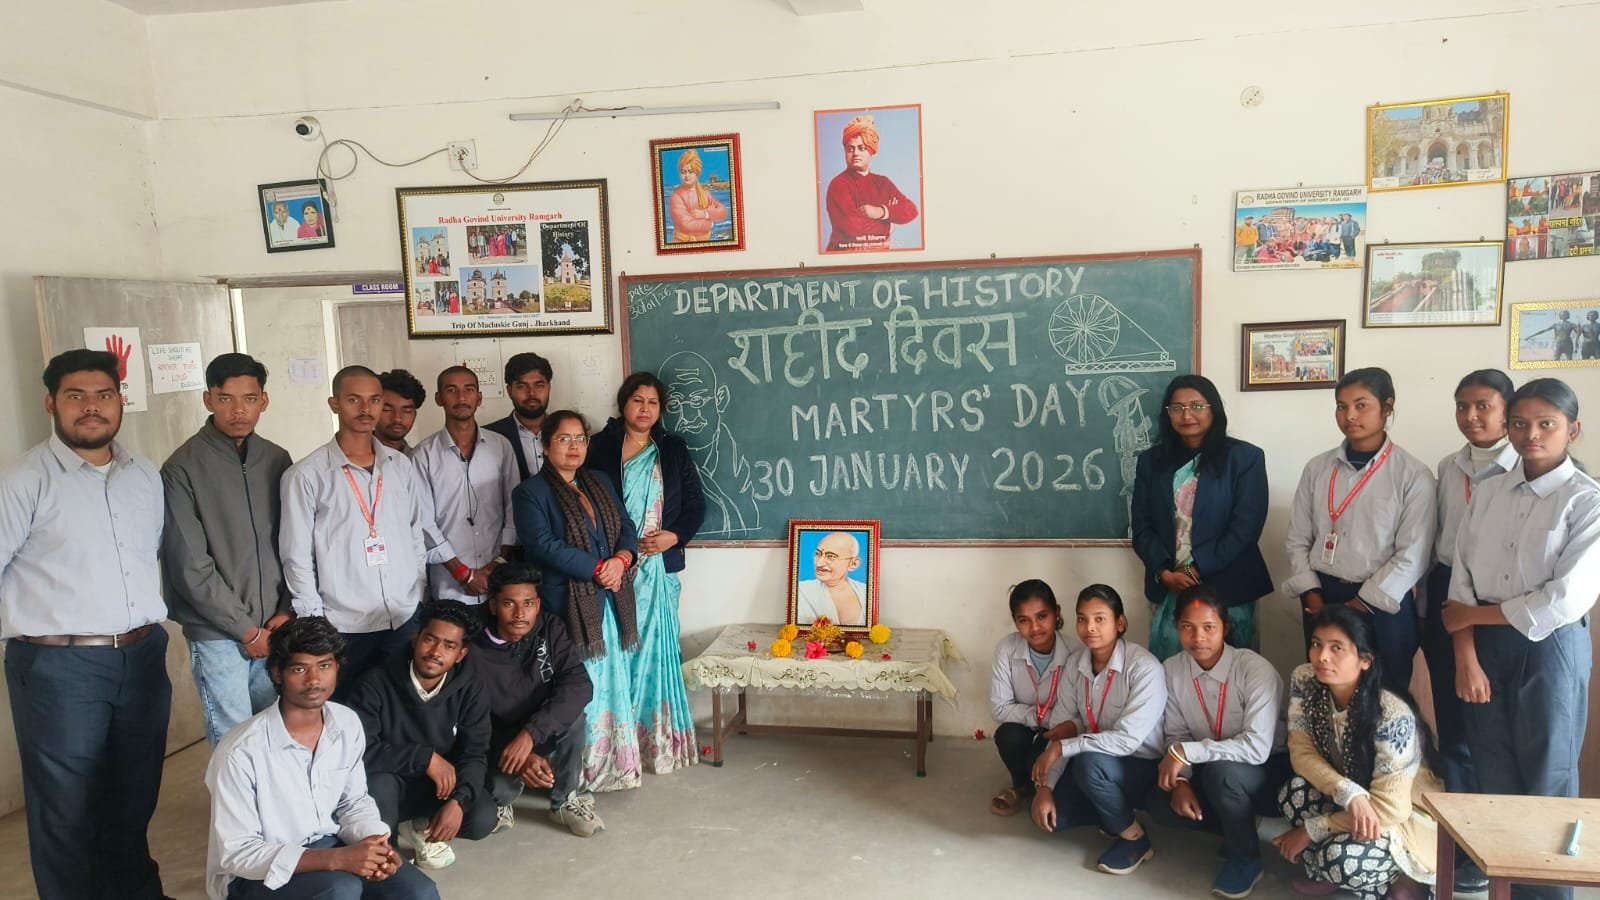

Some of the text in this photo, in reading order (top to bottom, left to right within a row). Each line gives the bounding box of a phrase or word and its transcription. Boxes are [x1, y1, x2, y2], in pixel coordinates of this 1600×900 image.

[1256, 188, 1362, 201] RADHA GOVIND UNIVERSITY RAMGARH
[438, 211, 563, 225] Radha Govind University Ramgarh
[542, 221, 576, 231] Department
[361, 282, 399, 291] CLASS ROOM
[672, 266, 1085, 315] DEPARTMENT OF HISTORY
[451, 322, 466, 330] Trip
[467, 321, 476, 329] Of
[534, 318, 571, 328] Jharkhand
[727, 304, 1027, 387] शहीद दिवस
[1010, 379, 1092, 428] DAY
[752, 447, 1106, 501] 30 JANUARY 2026
